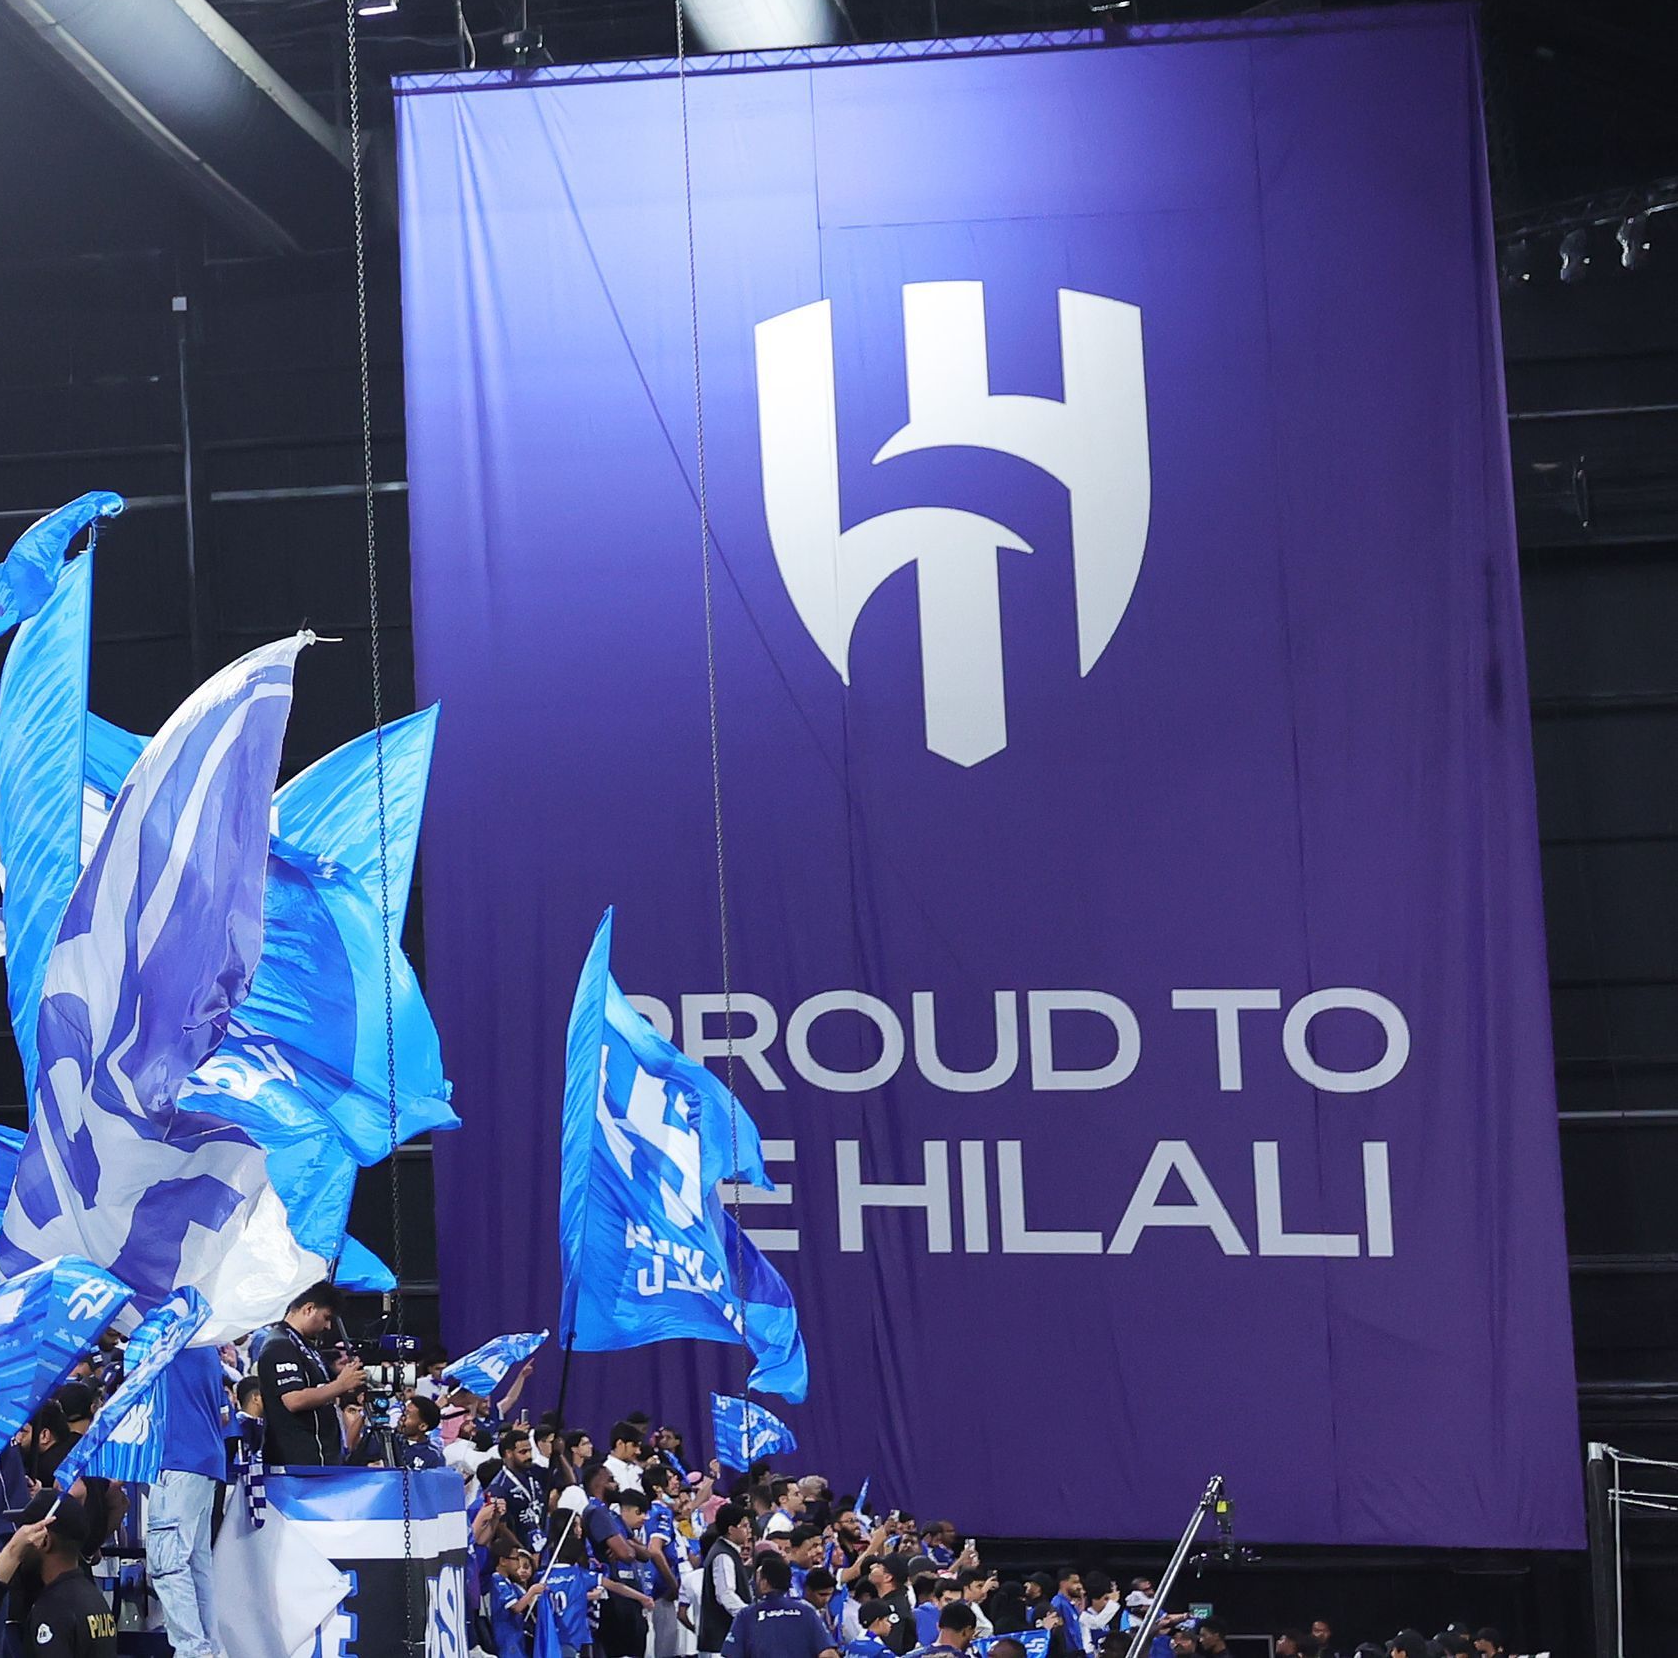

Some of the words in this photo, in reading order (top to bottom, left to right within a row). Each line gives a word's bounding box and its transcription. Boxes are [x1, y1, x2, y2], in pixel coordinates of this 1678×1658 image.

[1170, 987, 1411, 1094] TO
[716, 1139, 799, 1251] E
[834, 1139, 1394, 1258] HILALI
